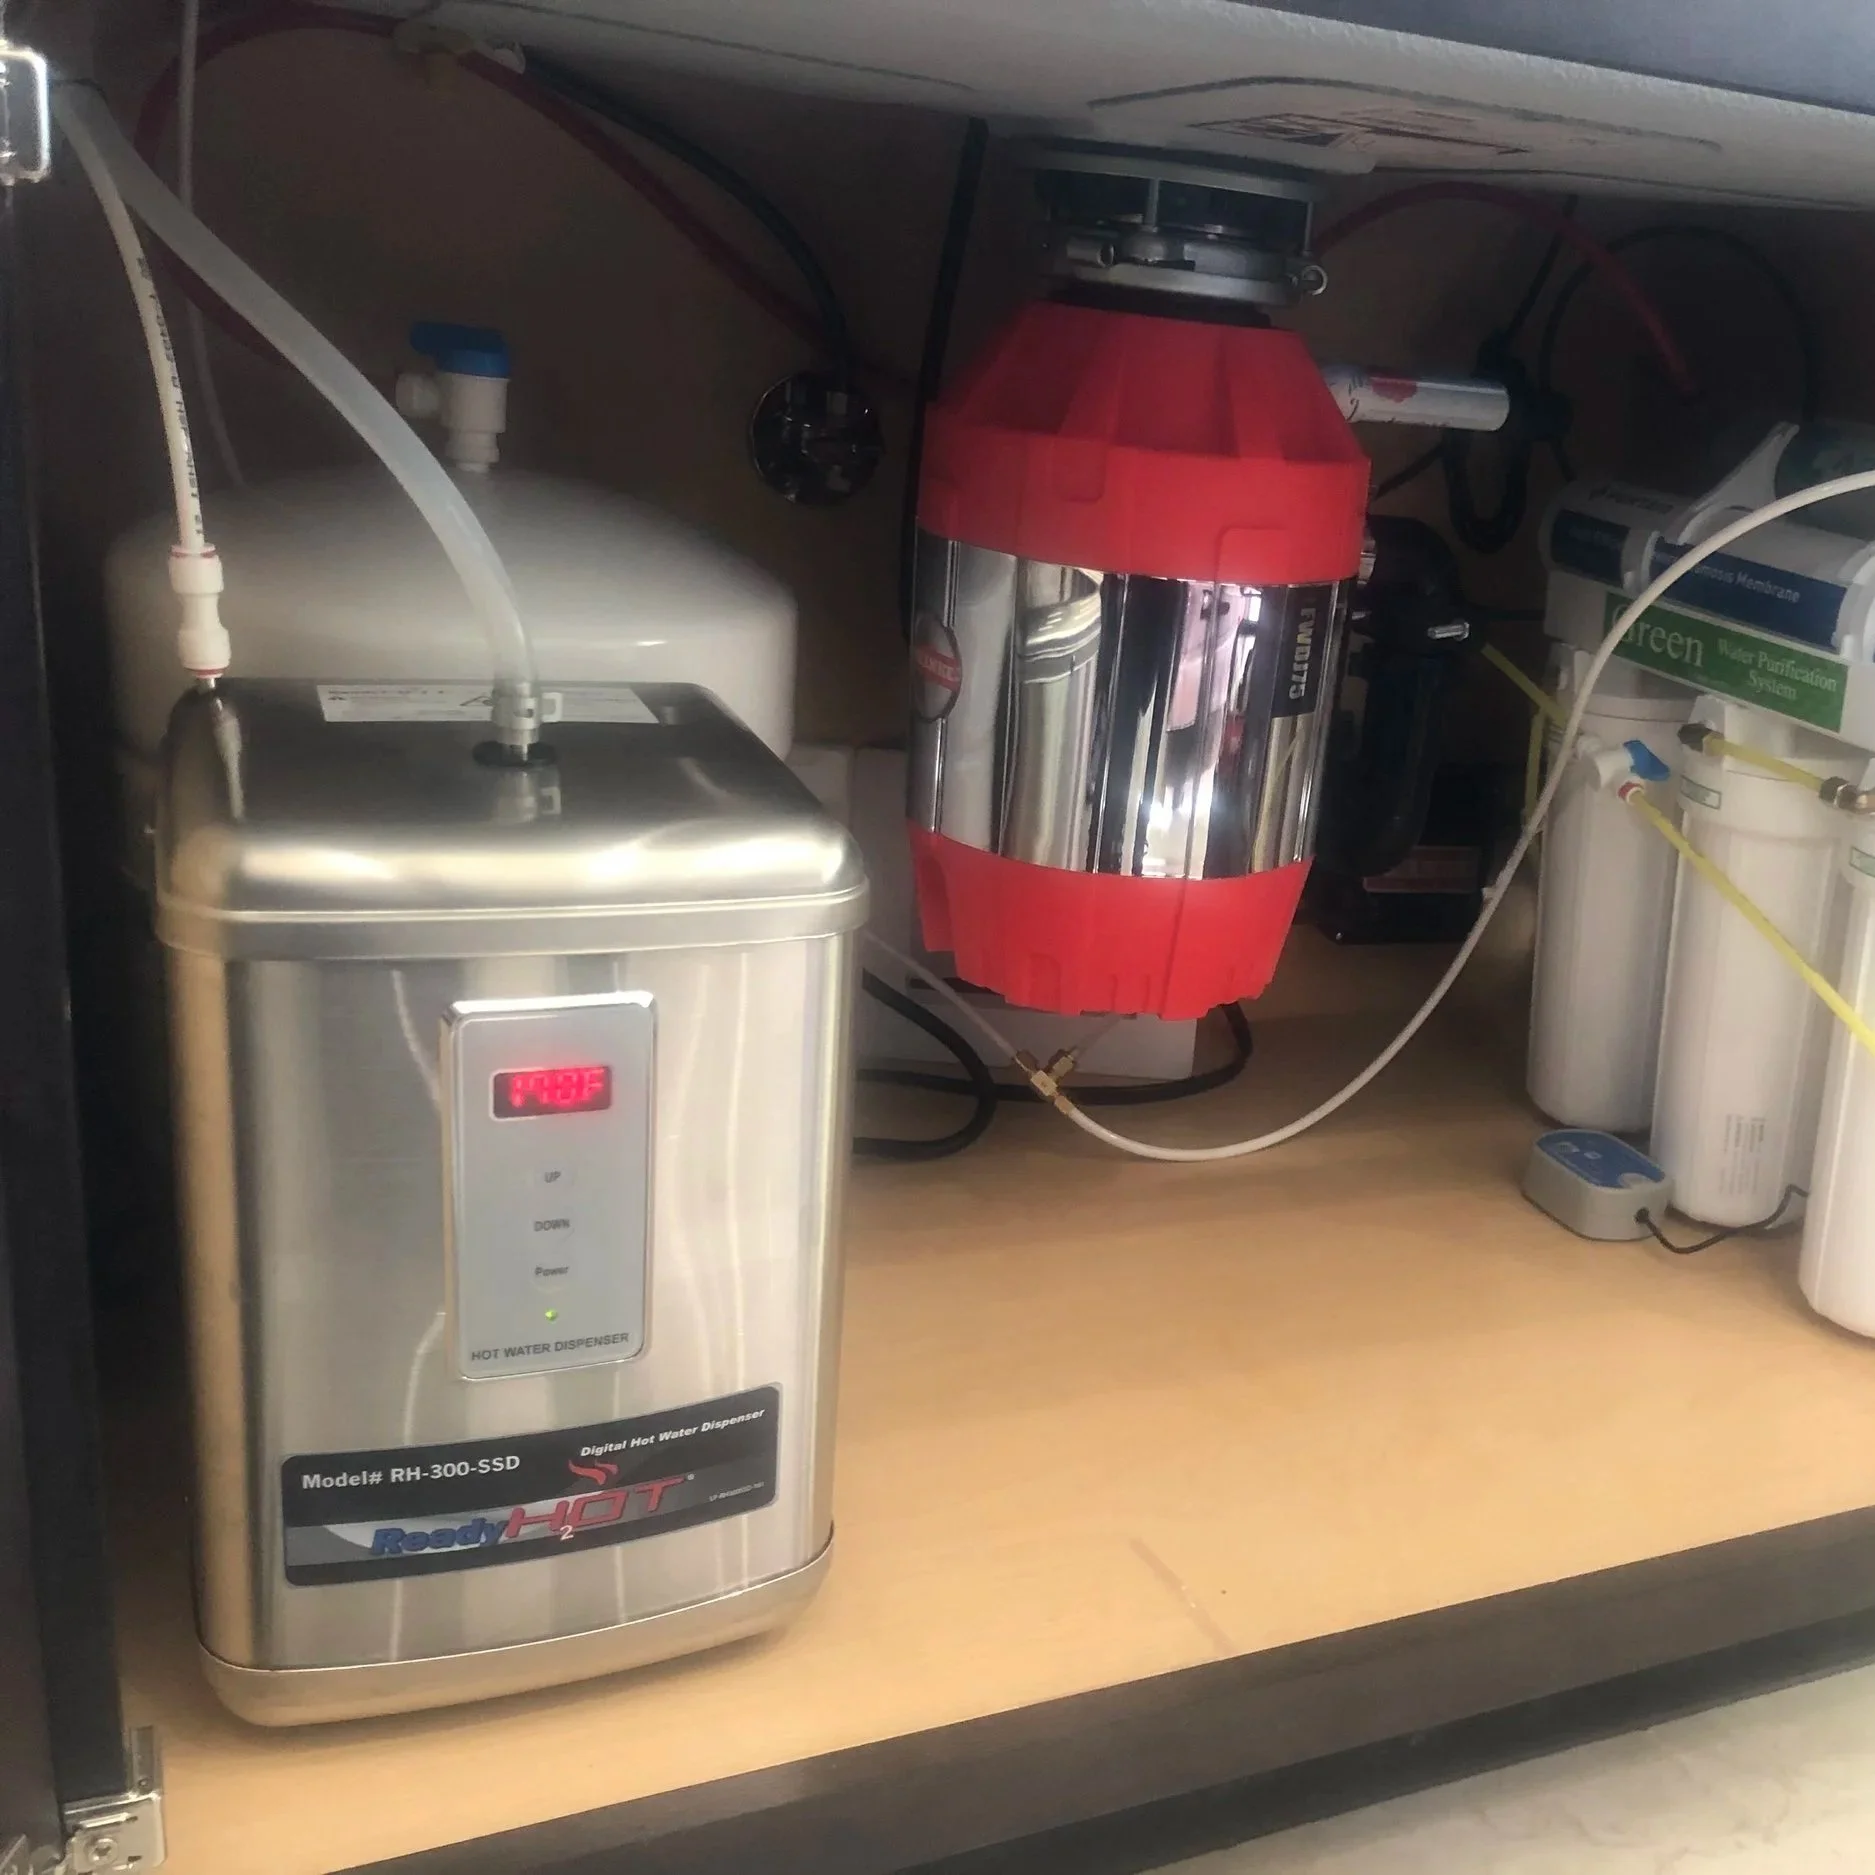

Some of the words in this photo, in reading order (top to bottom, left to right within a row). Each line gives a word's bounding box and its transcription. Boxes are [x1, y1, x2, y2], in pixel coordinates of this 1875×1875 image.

[1735, 569, 1801, 604] Membrane
[1717, 637, 1756, 667] Water
[1757, 651, 1838, 693] Purification
[1747, 669, 1798, 701] System
[544, 1170, 562, 1184] UP
[533, 1218, 571, 1232] DOWN
[534, 1265, 570, 1278] Power
[470, 1348, 499, 1361] HOT
[503, 1342, 551, 1358] WATER
[554, 1331, 630, 1352] DISPENSER
[579, 1439, 627, 1458] Digital
[630, 1433, 655, 1449] Hot
[658, 1424, 699, 1443] Water
[701, 1407, 766, 1433] Dispenser
[302, 1471, 384, 1490] Model#
[390, 1454, 521, 1484] RH-300-SSD
